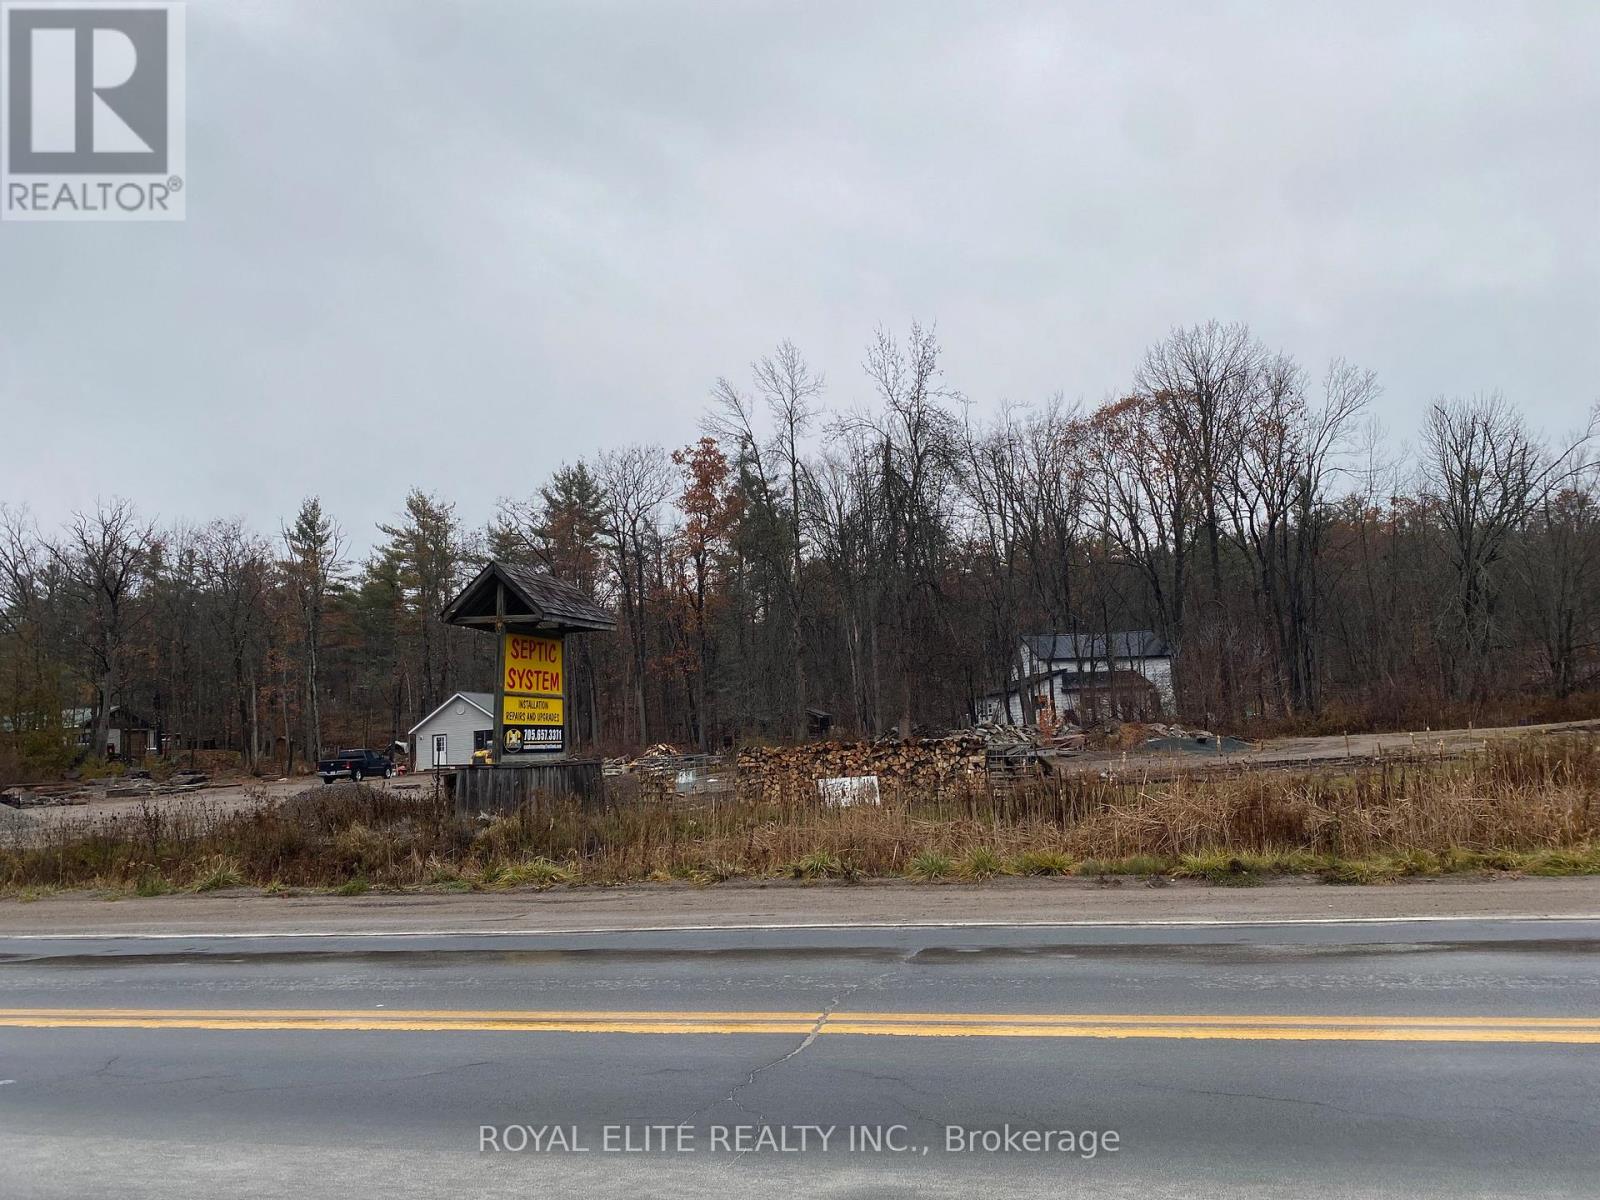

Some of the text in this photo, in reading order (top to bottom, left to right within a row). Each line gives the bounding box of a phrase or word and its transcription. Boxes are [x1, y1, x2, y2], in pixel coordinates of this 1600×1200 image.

[511, 638, 557, 663] SEPTIC
[507, 667, 560, 692] SYSTEM
[519, 700, 549, 710] INSTALLATION
[505, 712, 560, 723] REPAIRS AND UPGRADES
